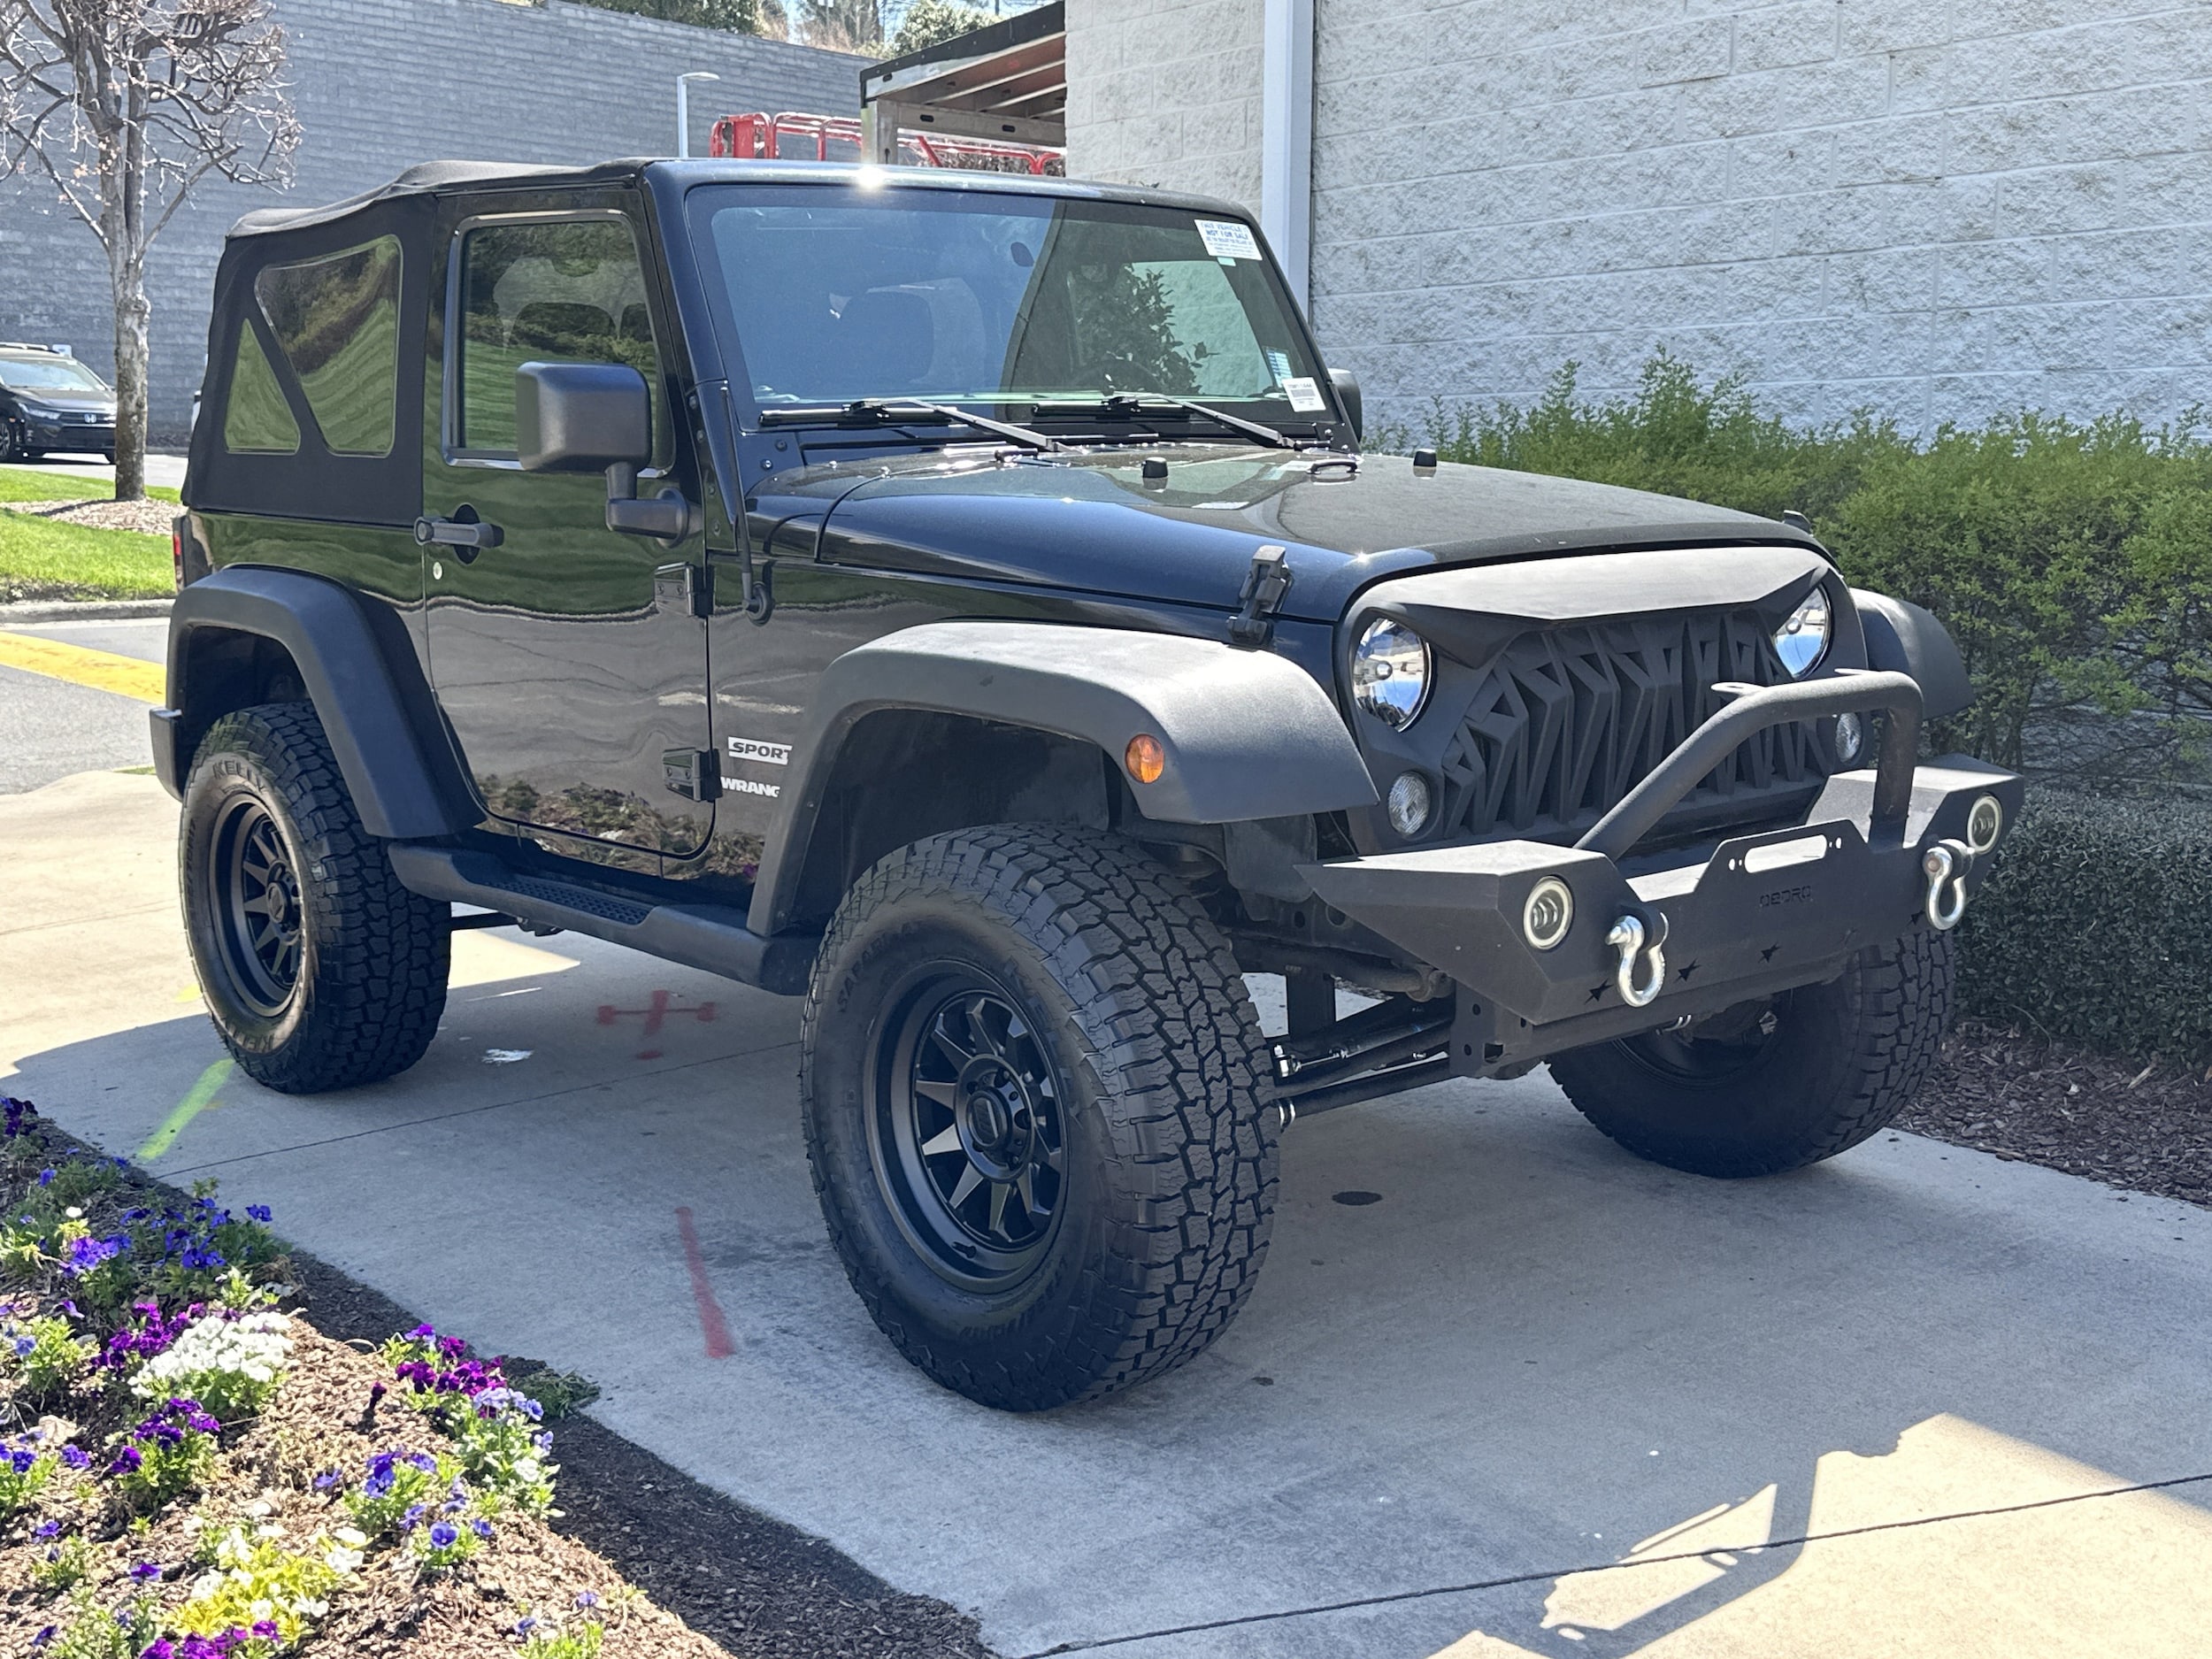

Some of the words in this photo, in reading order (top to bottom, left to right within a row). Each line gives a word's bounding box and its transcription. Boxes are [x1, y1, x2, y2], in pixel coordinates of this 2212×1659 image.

[729, 740, 792, 762] SPORT
[212, 759, 266, 795] KELLY
[720, 776, 780, 798] WRANG
